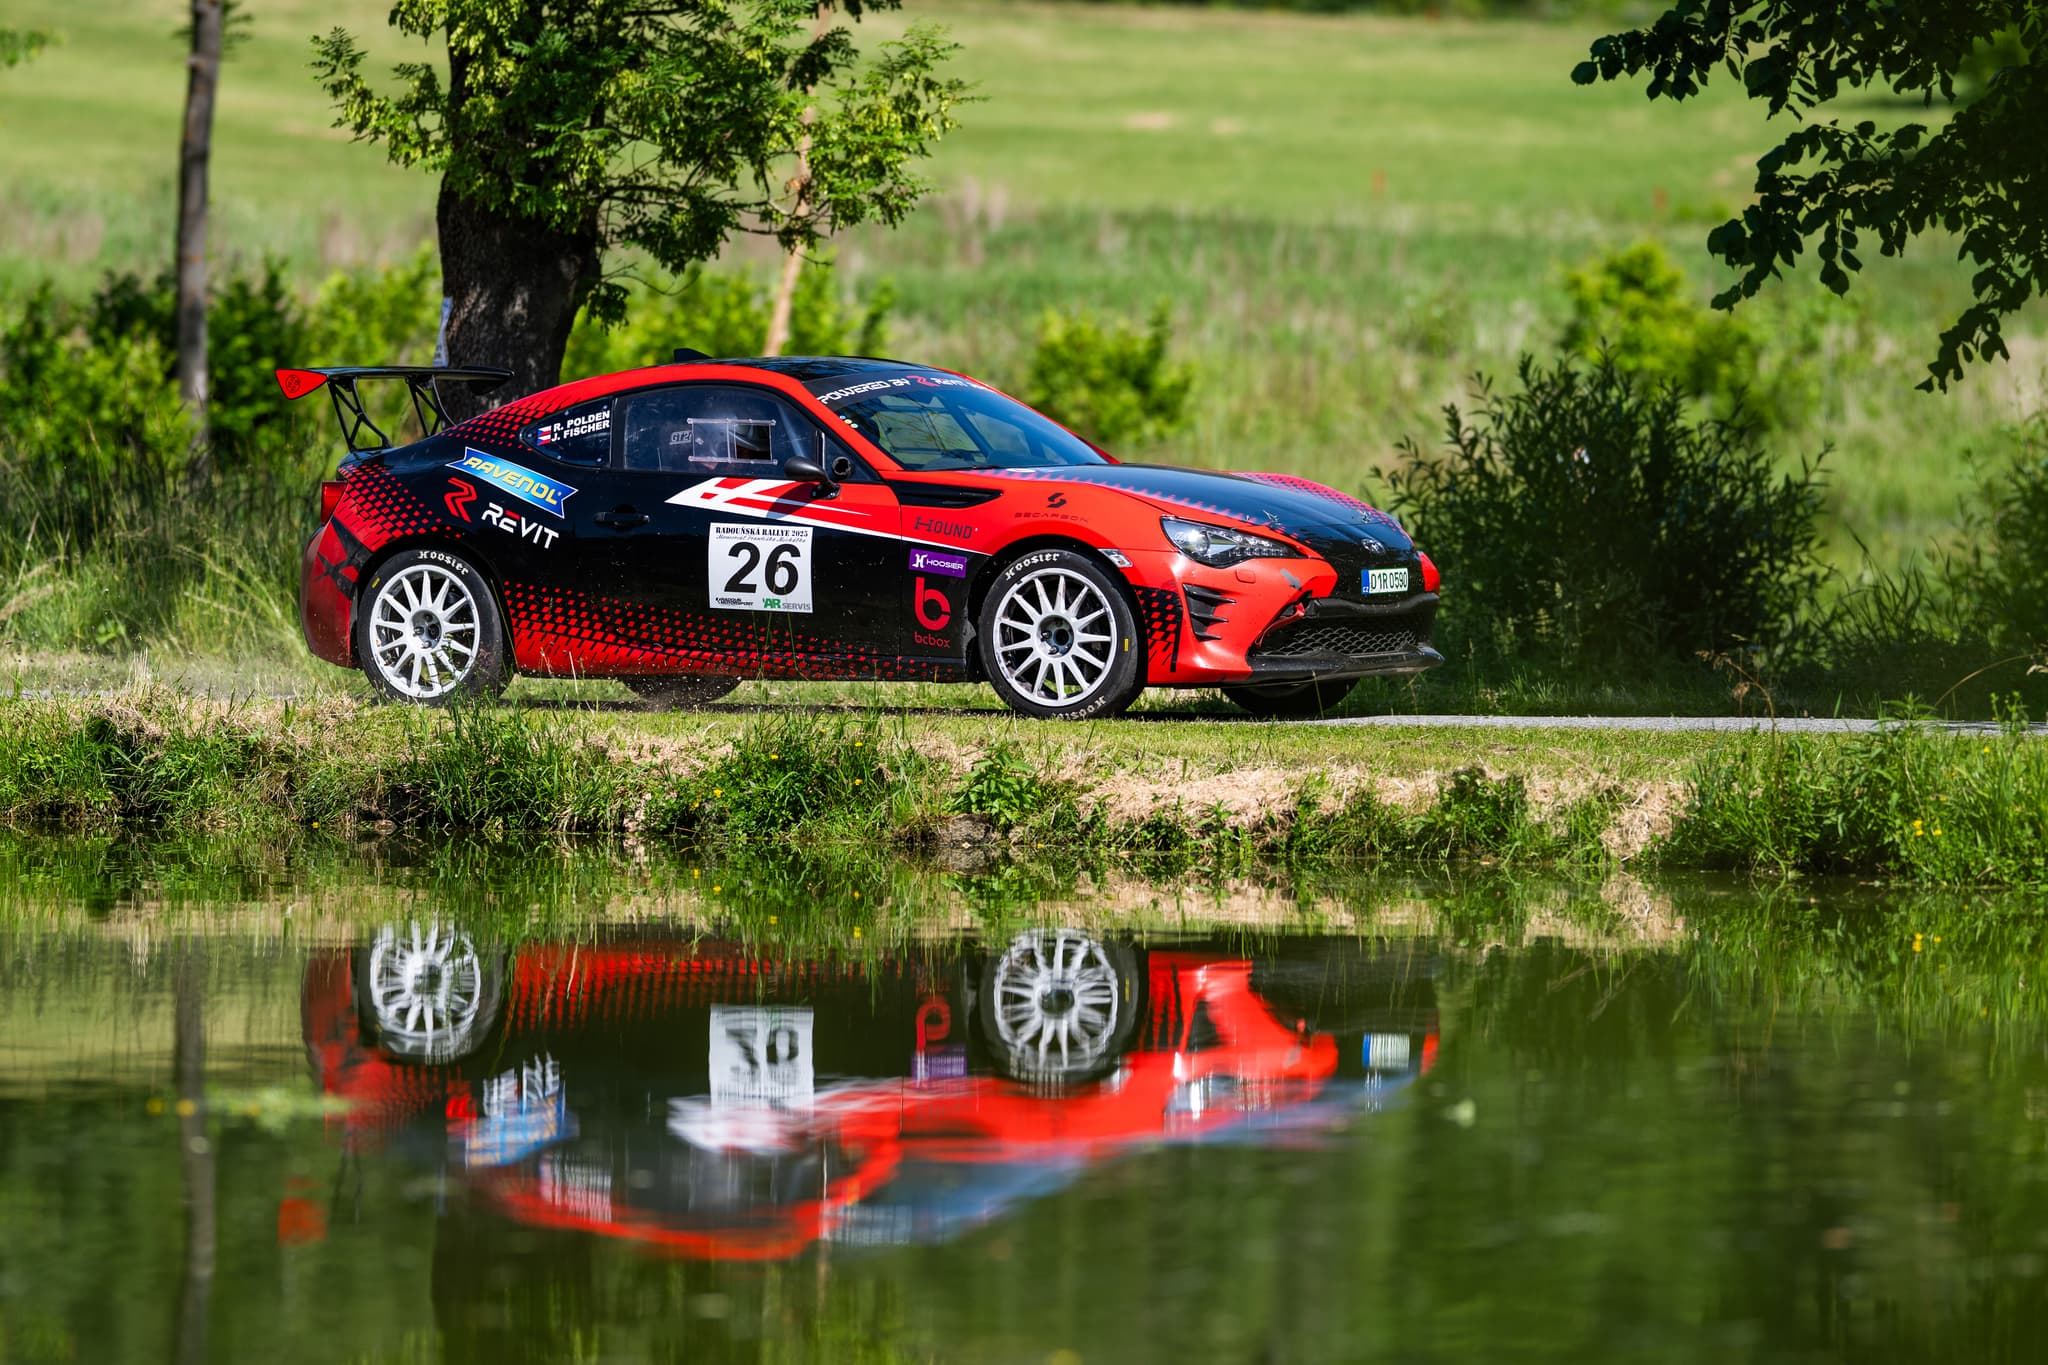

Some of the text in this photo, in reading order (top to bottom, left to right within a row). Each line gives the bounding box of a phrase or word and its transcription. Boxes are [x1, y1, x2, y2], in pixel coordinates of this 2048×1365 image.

[816, 381, 891, 404] POWERED
[551, 420, 610, 442] J. FISCHER
[553, 410, 610, 432] R. POLDEN
[463, 456, 558, 505] RAVENOL
[481, 502, 560, 549] REVIT
[762, 528, 790, 537] RALLYE
[913, 515, 973, 540] HOUND
[724, 541, 801, 596] 26
[926, 558, 964, 571] HOOSIER
[782, 602, 811, 610] SERVIS
[913, 631, 950, 649] bcbox
